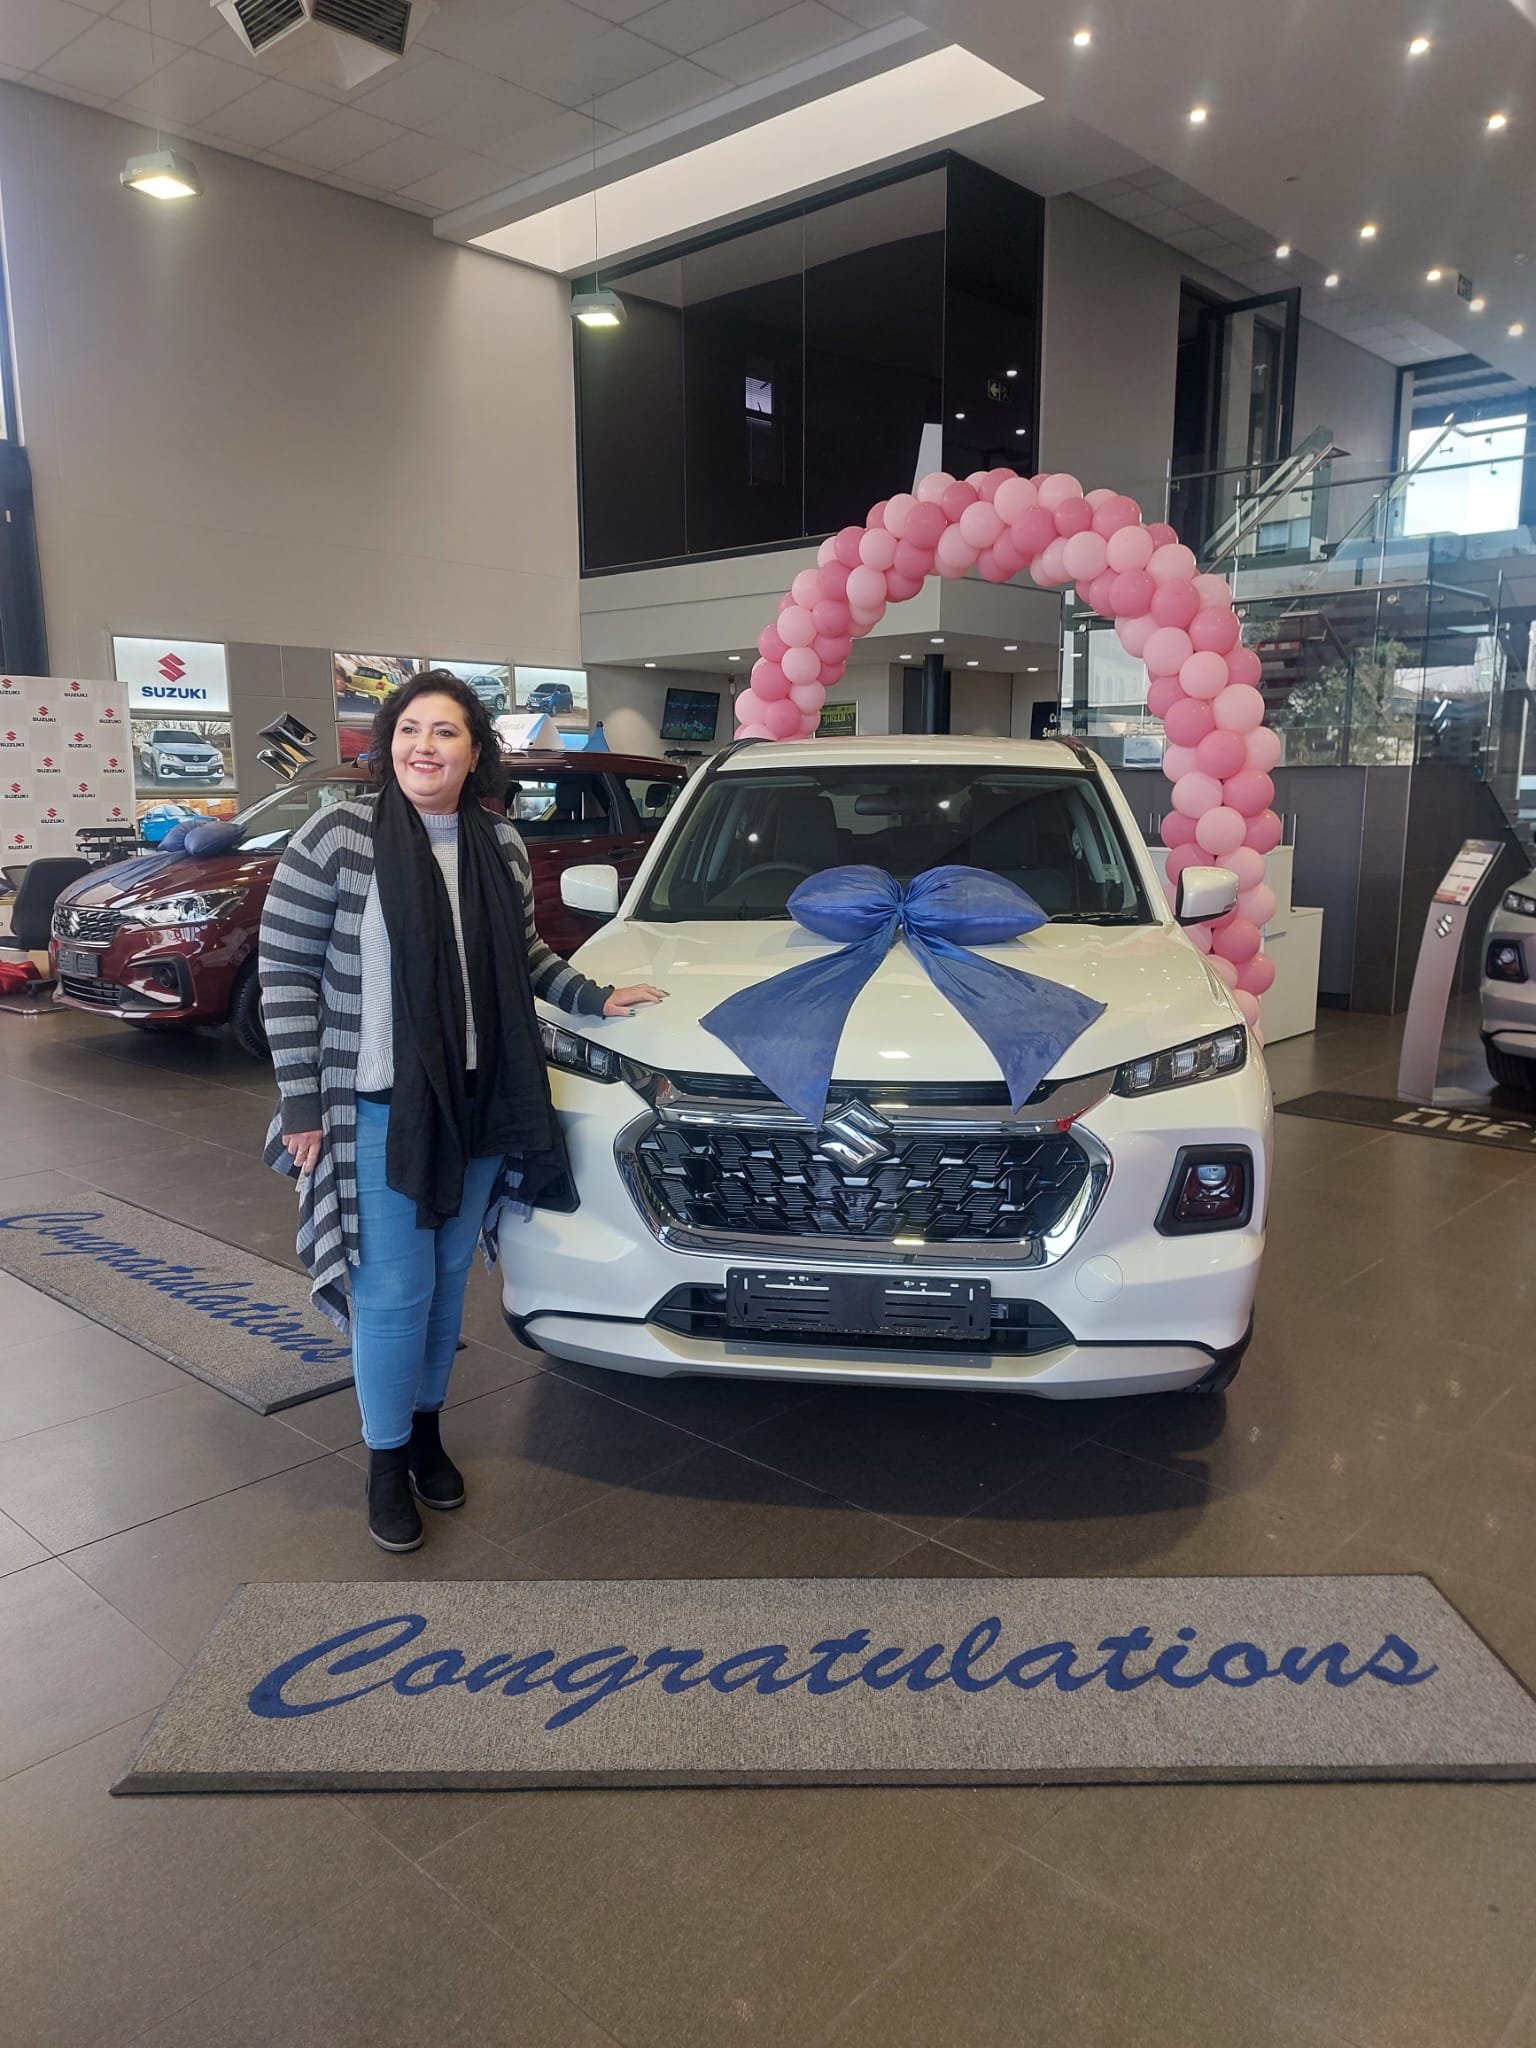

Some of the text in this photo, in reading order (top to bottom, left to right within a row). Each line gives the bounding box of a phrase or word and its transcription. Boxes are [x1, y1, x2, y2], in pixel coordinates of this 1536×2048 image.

[141, 686, 207, 699] SUZUKI
[1392, 1111, 1519, 1138] LIVE
[0, 1211, 352, 1363] Congratulations
[248, 1614, 1439, 1729] Congratulations
